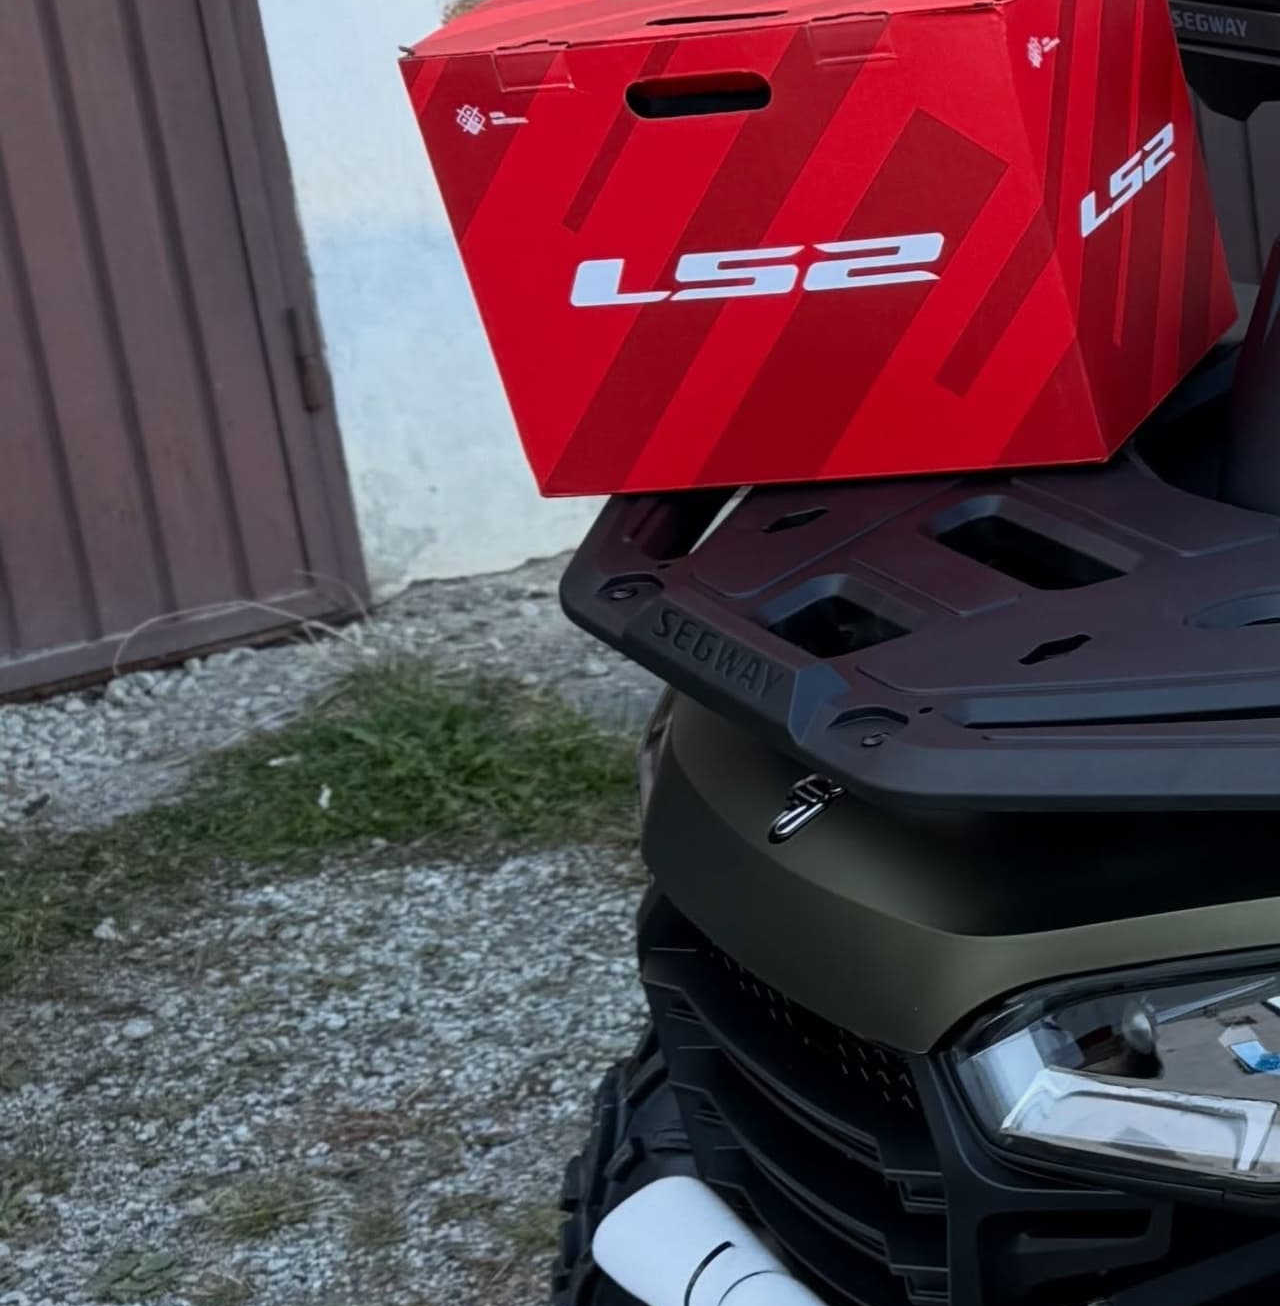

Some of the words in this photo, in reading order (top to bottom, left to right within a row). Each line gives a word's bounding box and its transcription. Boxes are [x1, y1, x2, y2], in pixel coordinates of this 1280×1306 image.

[1172, 9, 1247, 37] SEGWAY
[1080, 122, 1174, 238] LS2
[570, 232, 944, 307] LS2
[651, 608, 786, 699] SEGWAY
